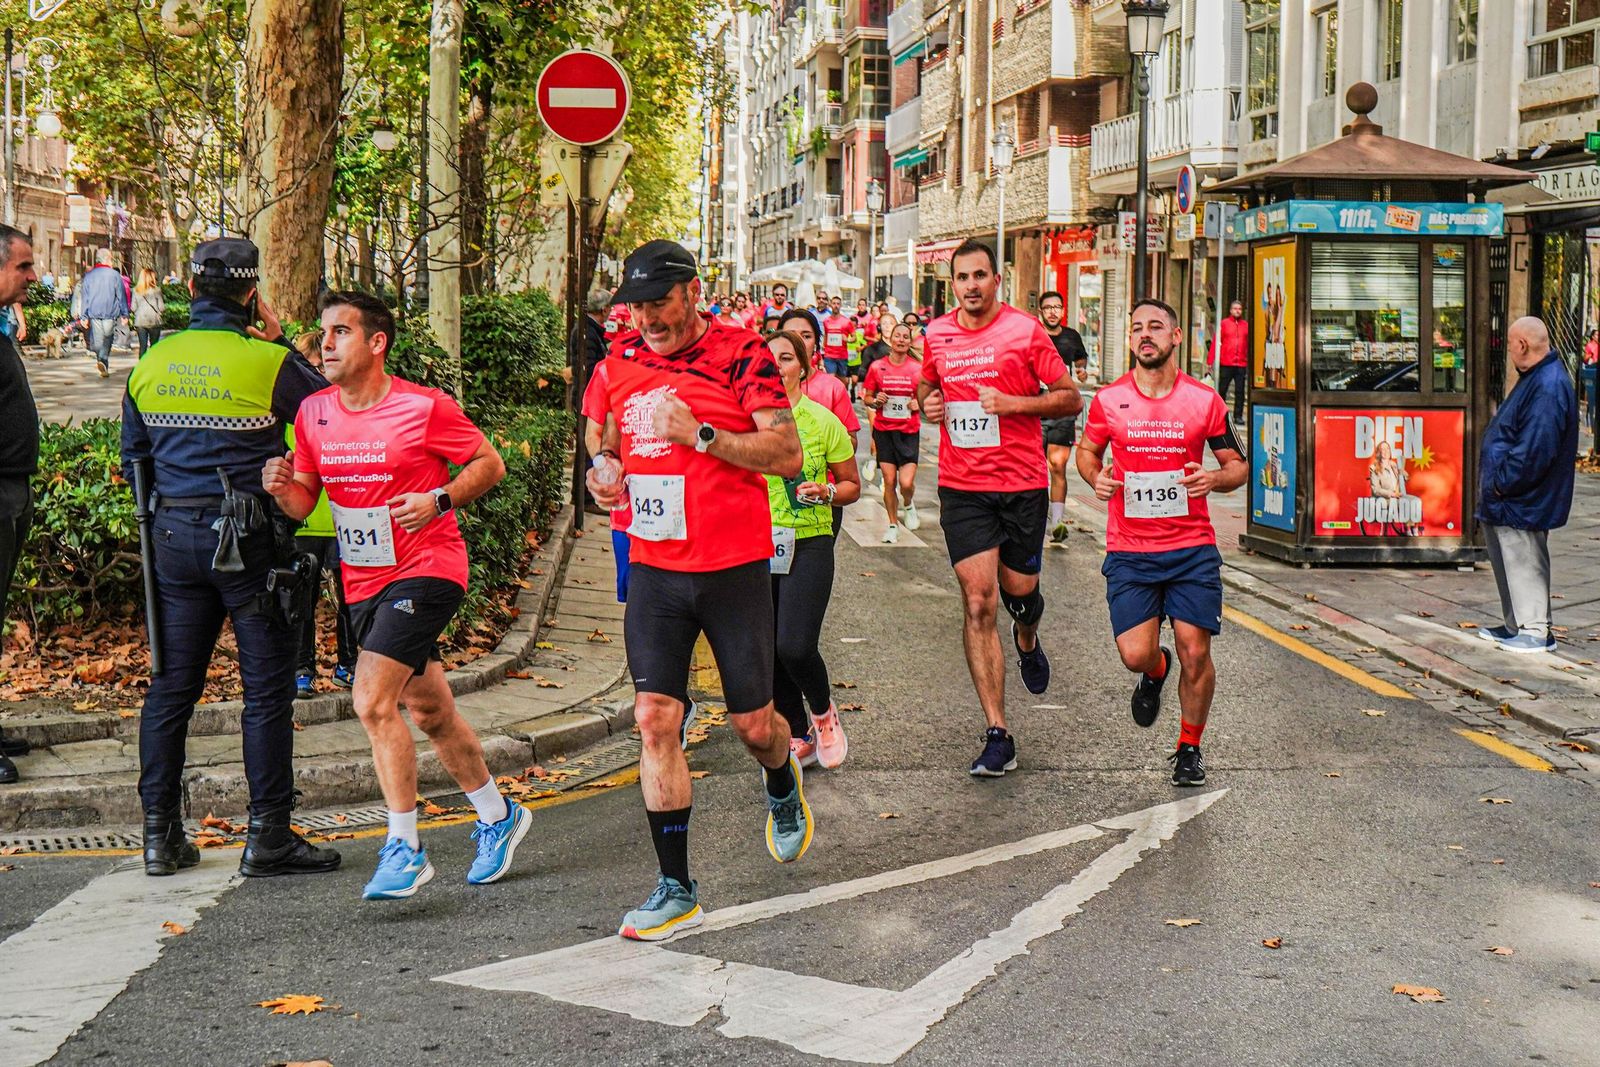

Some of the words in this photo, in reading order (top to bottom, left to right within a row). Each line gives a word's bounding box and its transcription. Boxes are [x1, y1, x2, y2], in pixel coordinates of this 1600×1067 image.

[1449, 213, 1489, 226] PREMIOS
[945, 354, 995, 369] humanidad
[168, 363, 221, 378] POLICIA
[180, 377, 208, 386] LOCAL
[156, 384, 233, 401] GRANADA
[892, 403, 903, 411] 28
[951, 418, 989, 431] 1137
[1173, 420, 1185, 429] de
[1127, 429, 1185, 439] humanidad
[1355, 415, 1424, 459] BIEN
[321, 441, 370, 451] kilómetros
[372, 440, 386, 449] de
[321, 452, 386, 465] humanidad
[1133, 487, 1178, 502] 1136
[1355, 497, 1422, 523] JUGADO
